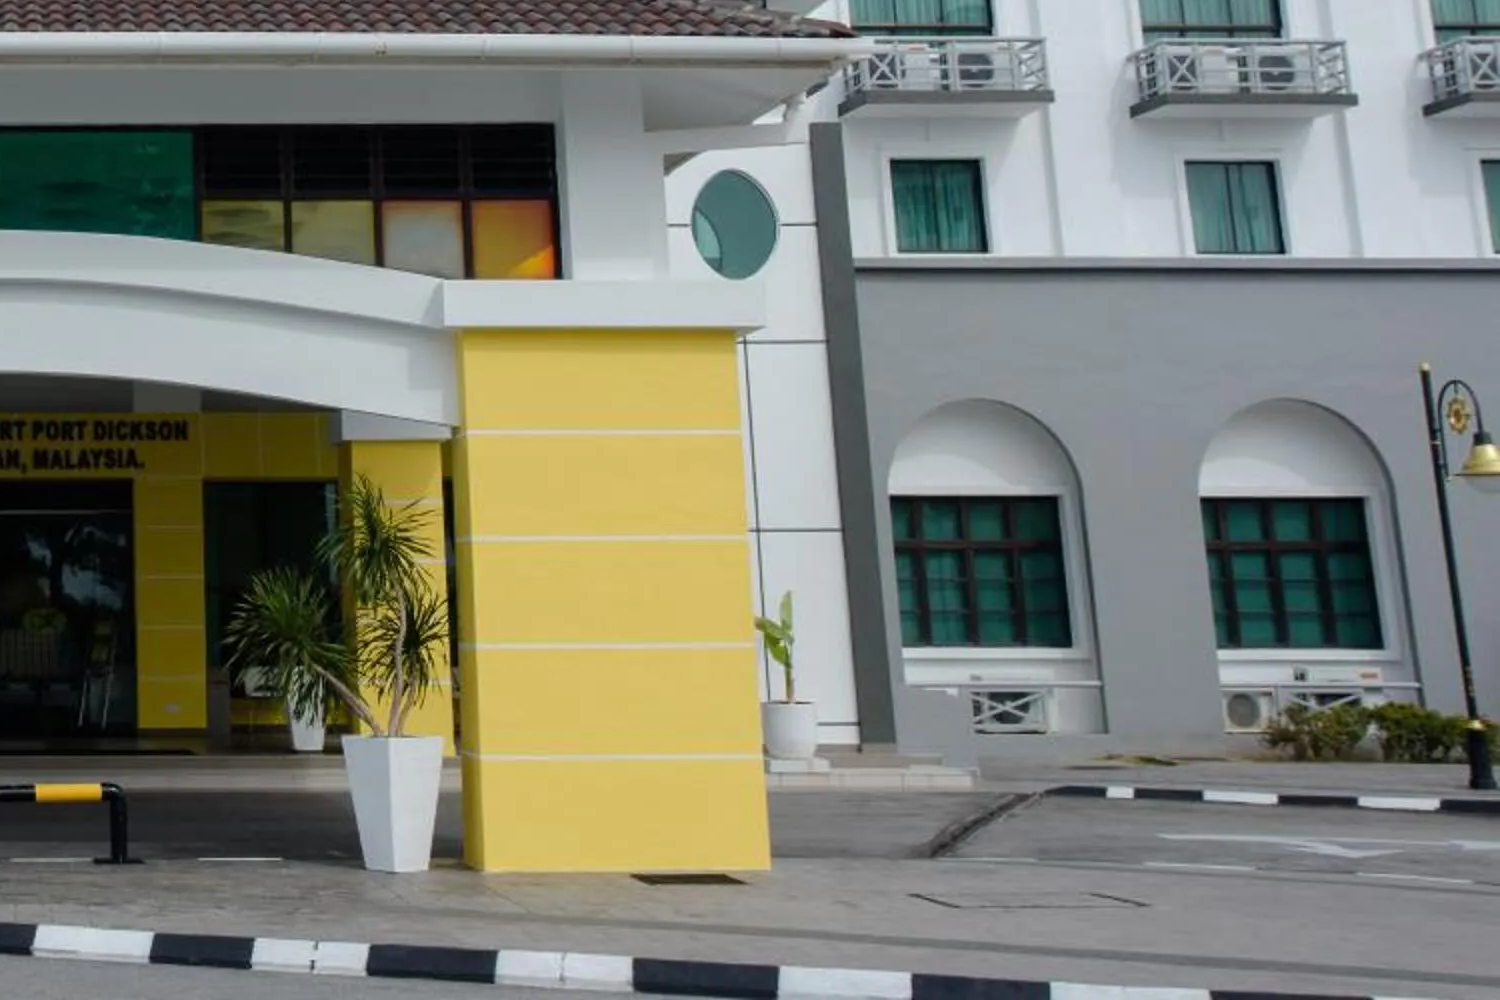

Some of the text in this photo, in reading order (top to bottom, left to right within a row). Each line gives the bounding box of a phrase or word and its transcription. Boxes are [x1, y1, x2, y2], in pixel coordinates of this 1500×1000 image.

[32, 420, 87, 440] PORT
[94, 420, 189, 440] DICKSON
[33, 449, 146, 470] MALAYSIA.
